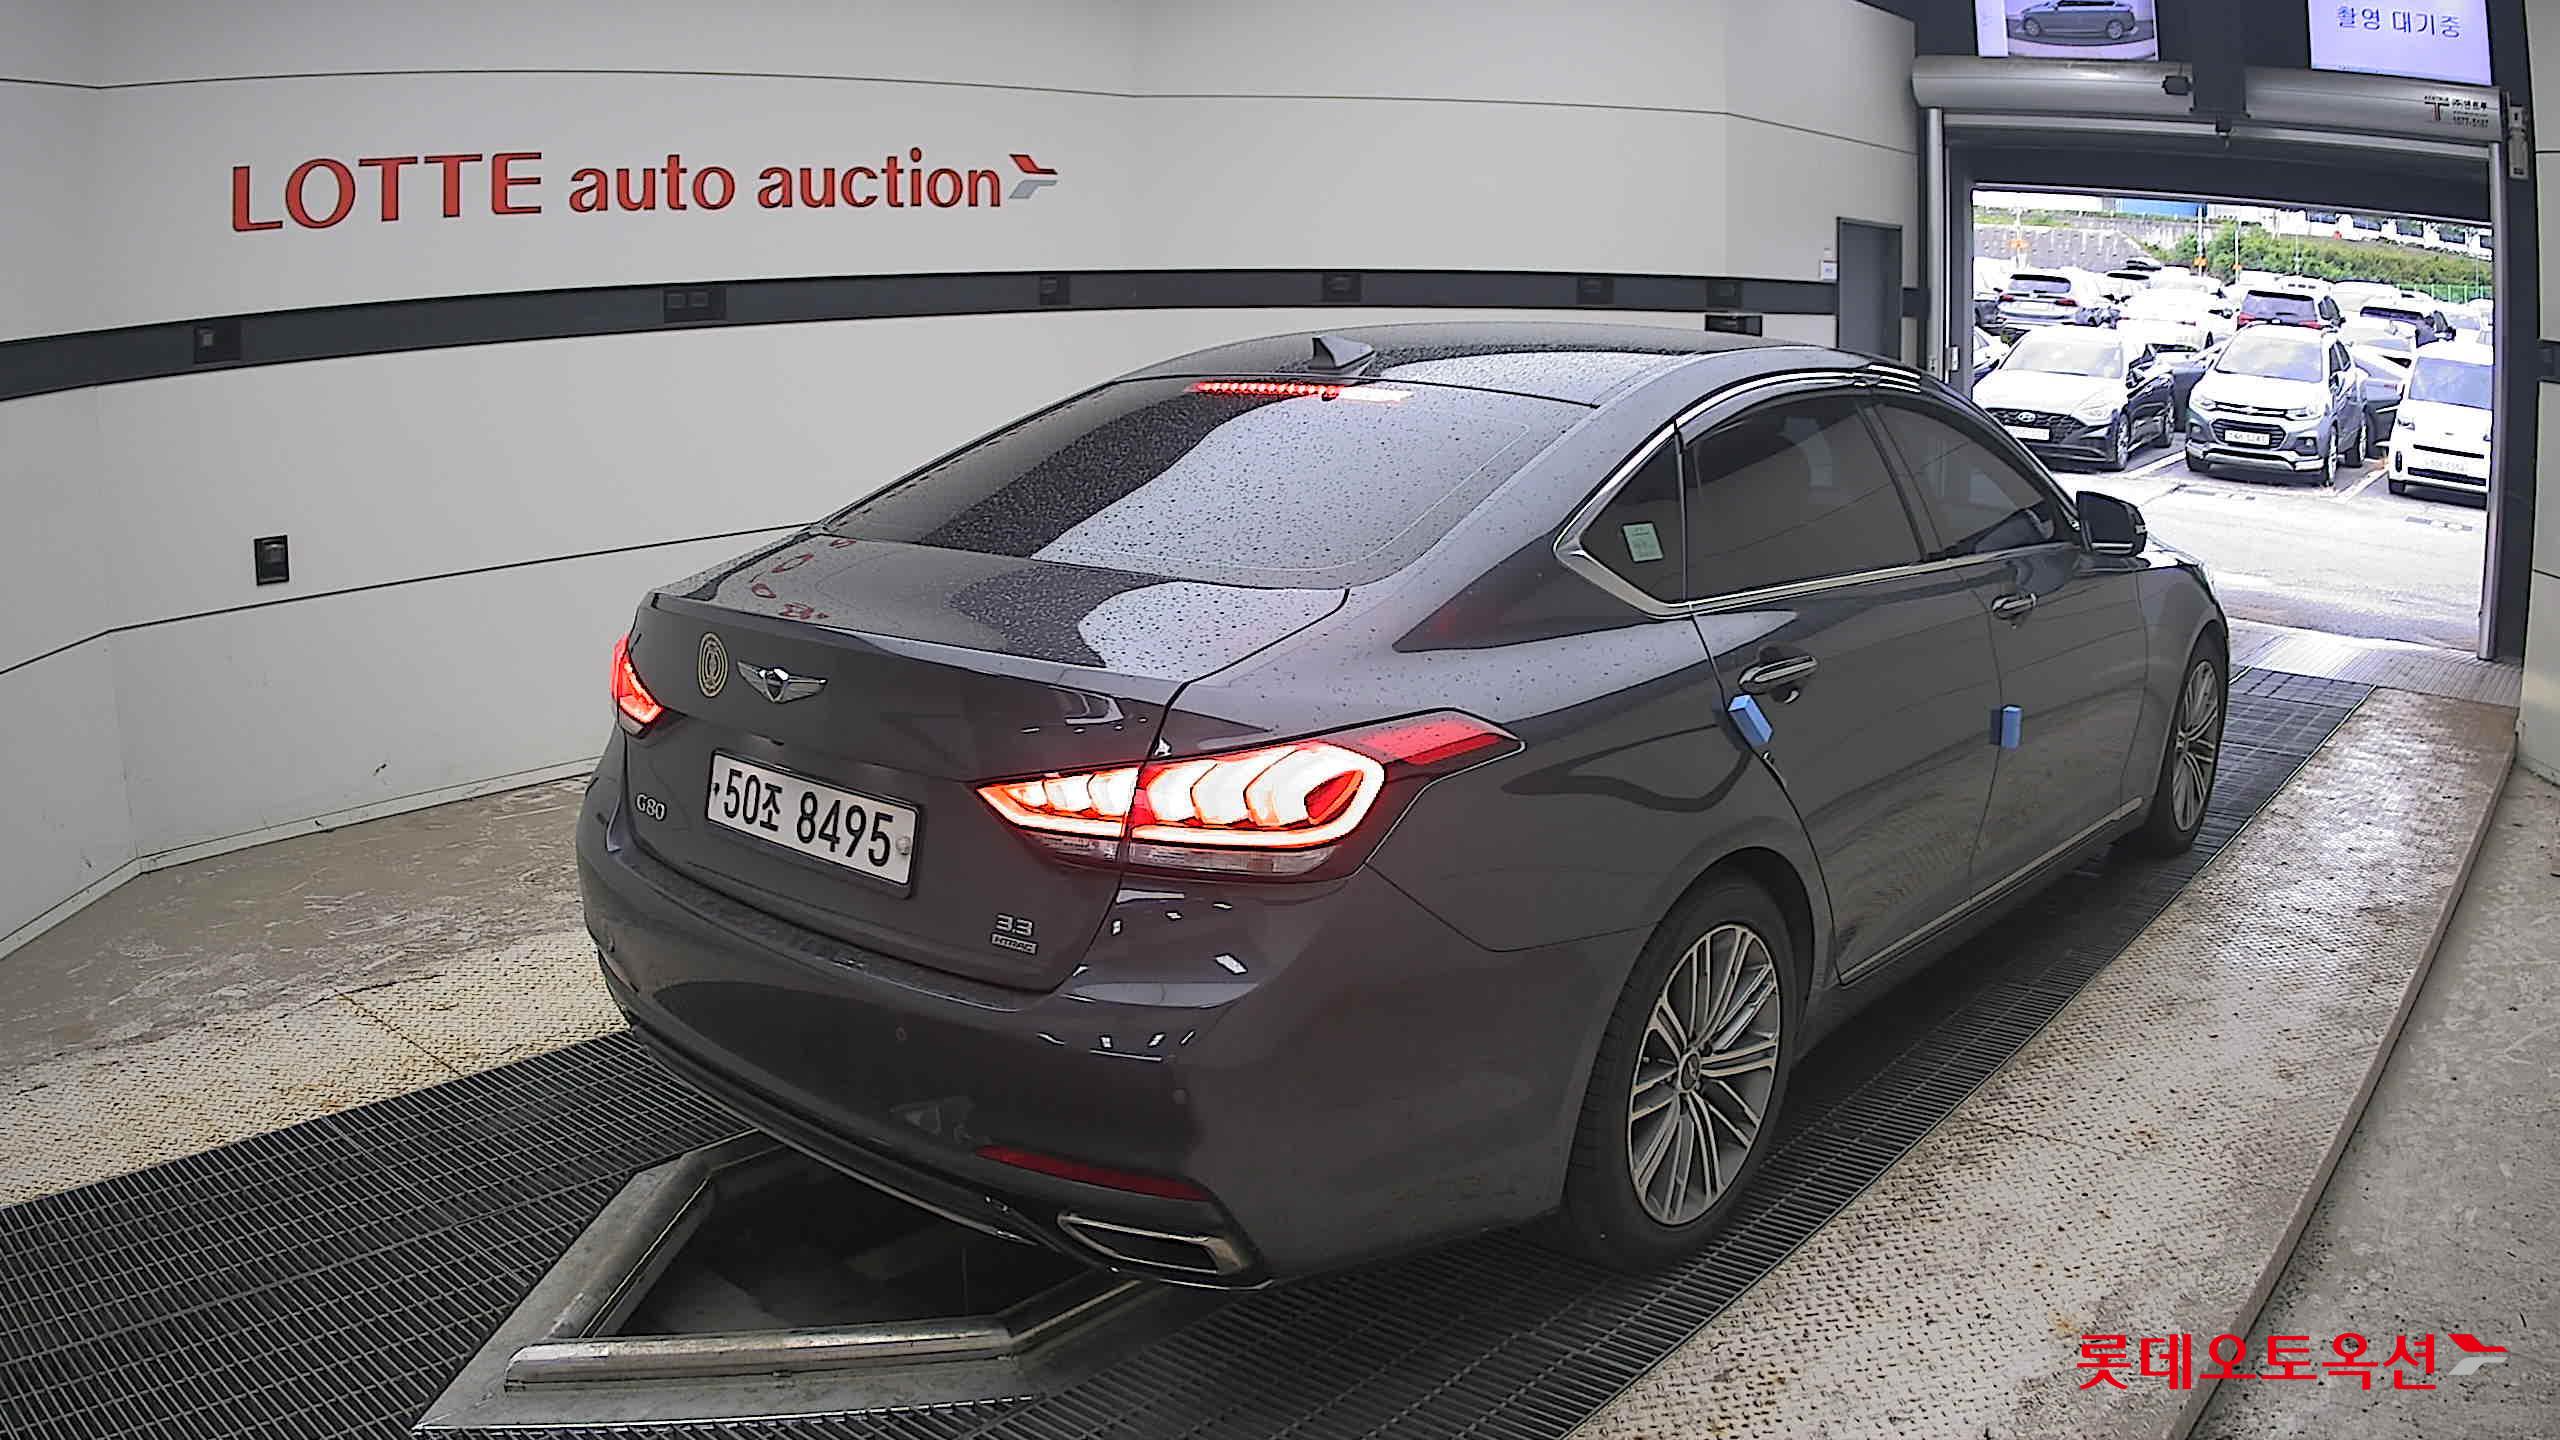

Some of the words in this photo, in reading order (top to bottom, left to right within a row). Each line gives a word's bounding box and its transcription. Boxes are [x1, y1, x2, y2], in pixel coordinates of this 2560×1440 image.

[2337, 5, 2381, 30] 촬영
[2391, 11, 2461, 39] 대기중
[232, 152, 542, 232] LOTTE
[568, 154, 736, 213] auto
[757, 148, 1001, 209] auction
[636, 794, 666, 821] G80
[723, 769, 782, 832] 50조
[796, 791, 893, 867] 8495
[996, 913, 1033, 937] 3.3
